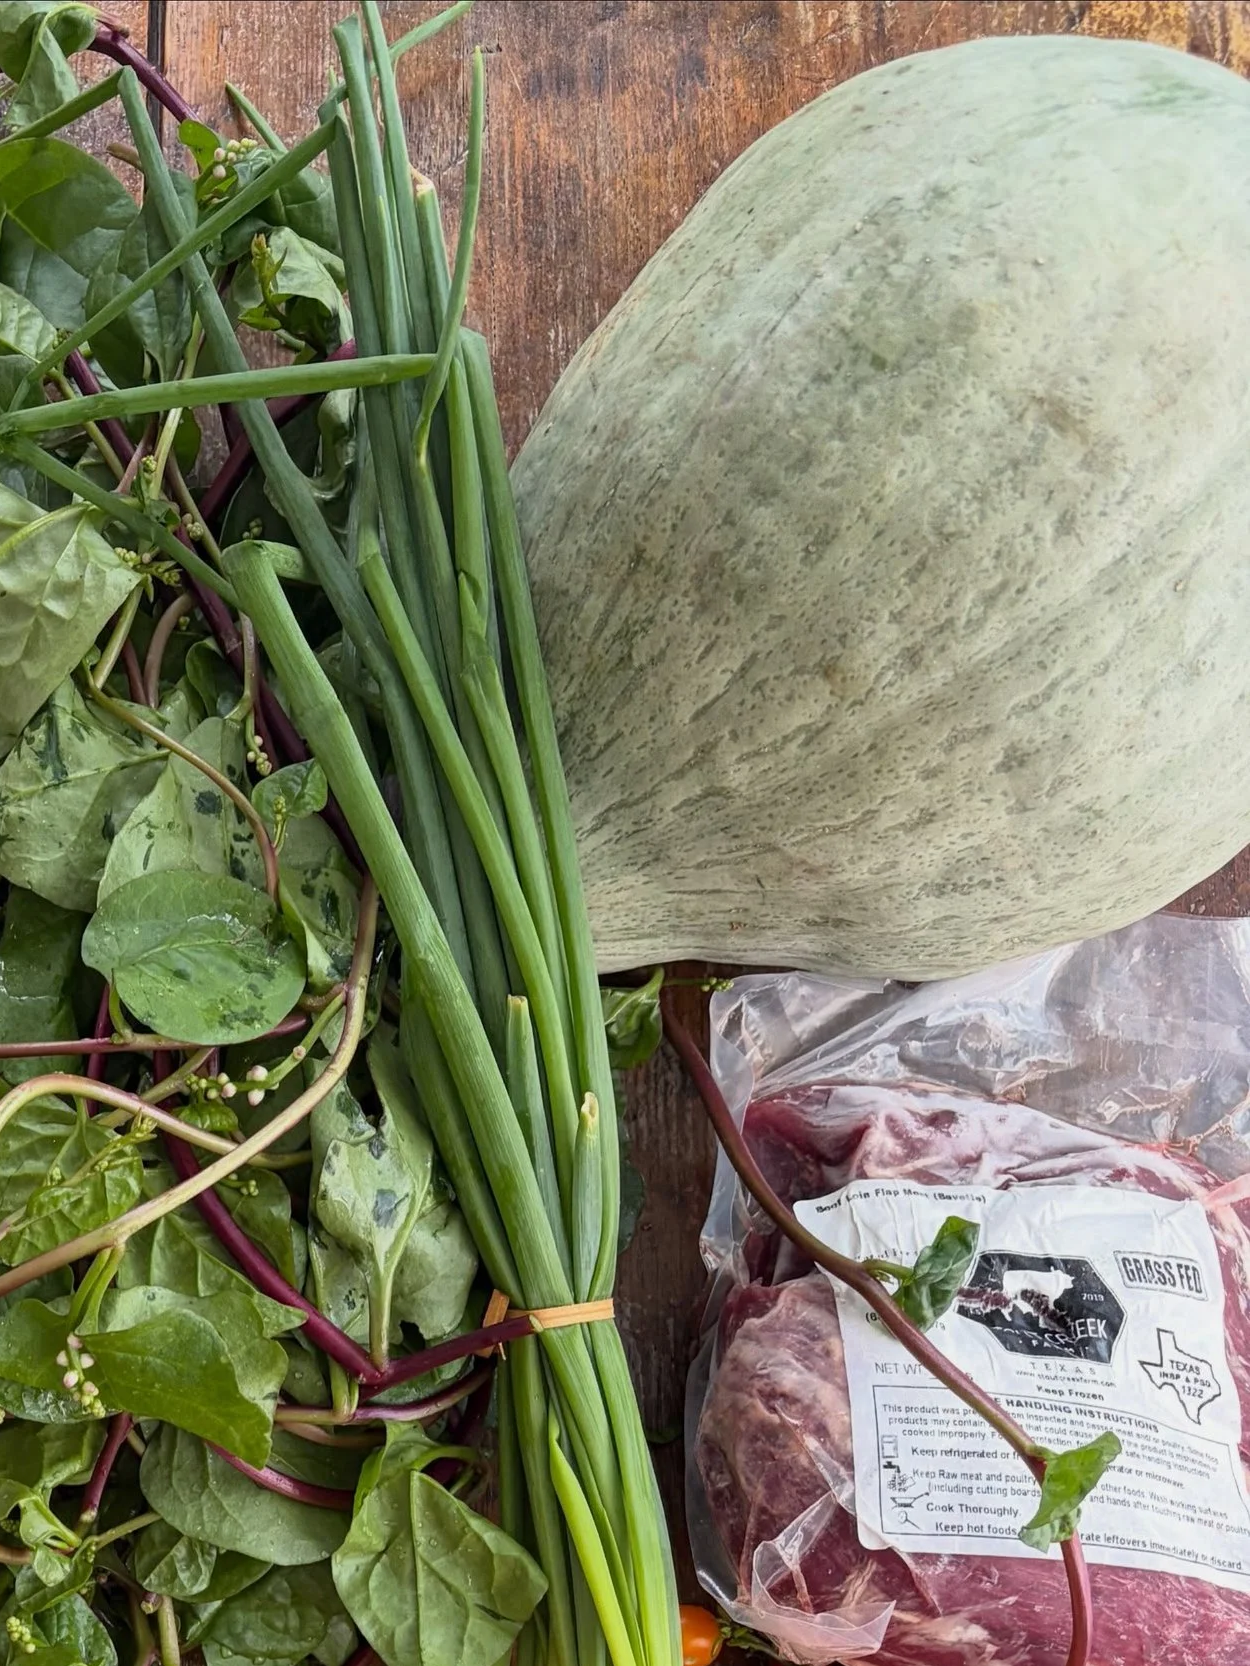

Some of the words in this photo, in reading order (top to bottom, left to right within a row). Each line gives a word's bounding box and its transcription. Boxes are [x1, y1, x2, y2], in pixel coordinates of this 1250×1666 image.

[875, 1188, 899, 1196] Flap
[1118, 1256, 1178, 1288] GRASS
[1173, 1262, 1205, 1294] FED
[874, 1362, 903, 1374] NET
[1168, 1359, 1201, 1375] TEXAS
[1035, 1384, 1065, 1397] Keep
[1068, 1389, 1104, 1402] Frozen
[1181, 1385, 1204, 1398] 1322
[882, 1403, 902, 1412] This
[904, 1405, 939, 1414] product
[941, 1407, 959, 1415] was
[1068, 1417, 1085, 1427] and
[1004, 1398, 1069, 1413] HANDLING
[1073, 1408, 1160, 1433] INSTRUCTIONS
[888, 1417, 928, 1425] products
[952, 1419, 986, 1427] contain
[1045, 1424, 1067, 1436] could
[901, 1427, 935, 1436] cooked
[911, 1446, 938, 1457] Keep
[939, 1447, 998, 1459] refrigerated
[999, 1451, 1010, 1459] or
[912, 1468, 935, 1478] Keep
[938, 1470, 957, 1479] Raw
[960, 1472, 982, 1480] meat
[985, 1473, 1002, 1481] and
[1004, 1473, 1036, 1485] poultry
[1100, 1482, 1121, 1494] other
[925, 1501, 954, 1513] Cook
[958, 1503, 1022, 1517] Thoroughly.
[976, 1485, 1007, 1496] cutting
[1089, 1494, 1105, 1504] and
[1106, 1495, 1131, 1508] hands
[1196, 1517, 1216, 1528] meat
[935, 1521, 964, 1533] Keep
[967, 1523, 983, 1533] hot
[986, 1524, 1017, 1535] foods
[1102, 1533, 1148, 1547] leftovers
